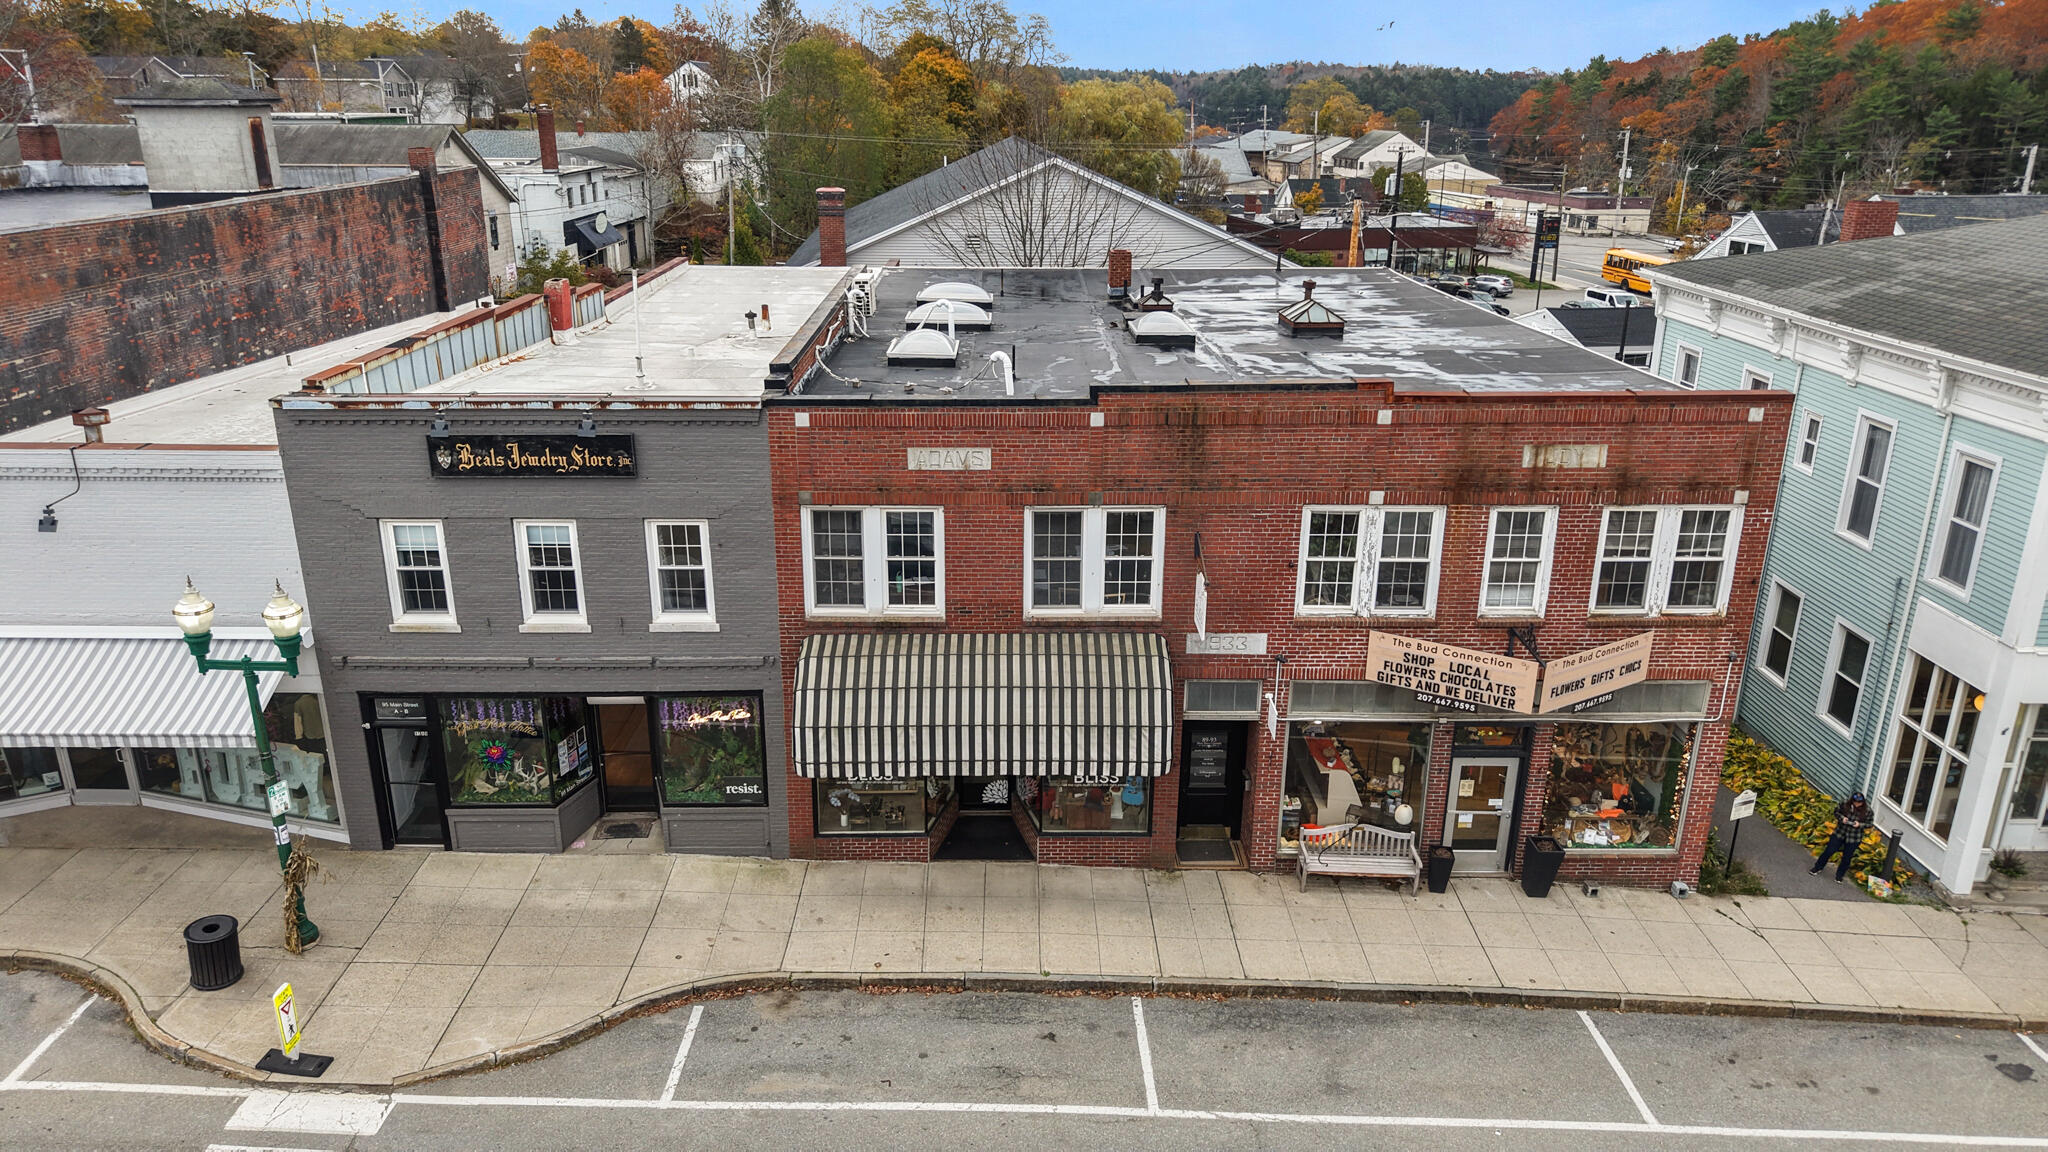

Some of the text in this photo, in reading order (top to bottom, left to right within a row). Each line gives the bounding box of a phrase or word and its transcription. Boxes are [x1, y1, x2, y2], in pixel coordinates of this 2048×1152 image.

[456, 443, 505, 471] Beals
[506, 443, 568, 472] Jewelry
[914, 451, 984, 468] ADAMS
[1392, 637, 1513, 669] The Bud Connection
[1403, 652, 1491, 681] SHOP LOCAL
[1562, 639, 1640, 669] The Bud Connection
[1377, 670, 1516, 710] GIFTS AND WE DELIVER
[1383, 660, 1517, 697] FLOWERS CHOCOLATES
[1550, 659, 1642, 699] FLOWERS GIFTS CHOCS
[1416, 693, 1476, 712] 207.667.9595
[1574, 693, 1613, 712] 207.667.9595
[725, 782, 763, 794] resist.
[1073, 774, 1120, 784] BLISS
